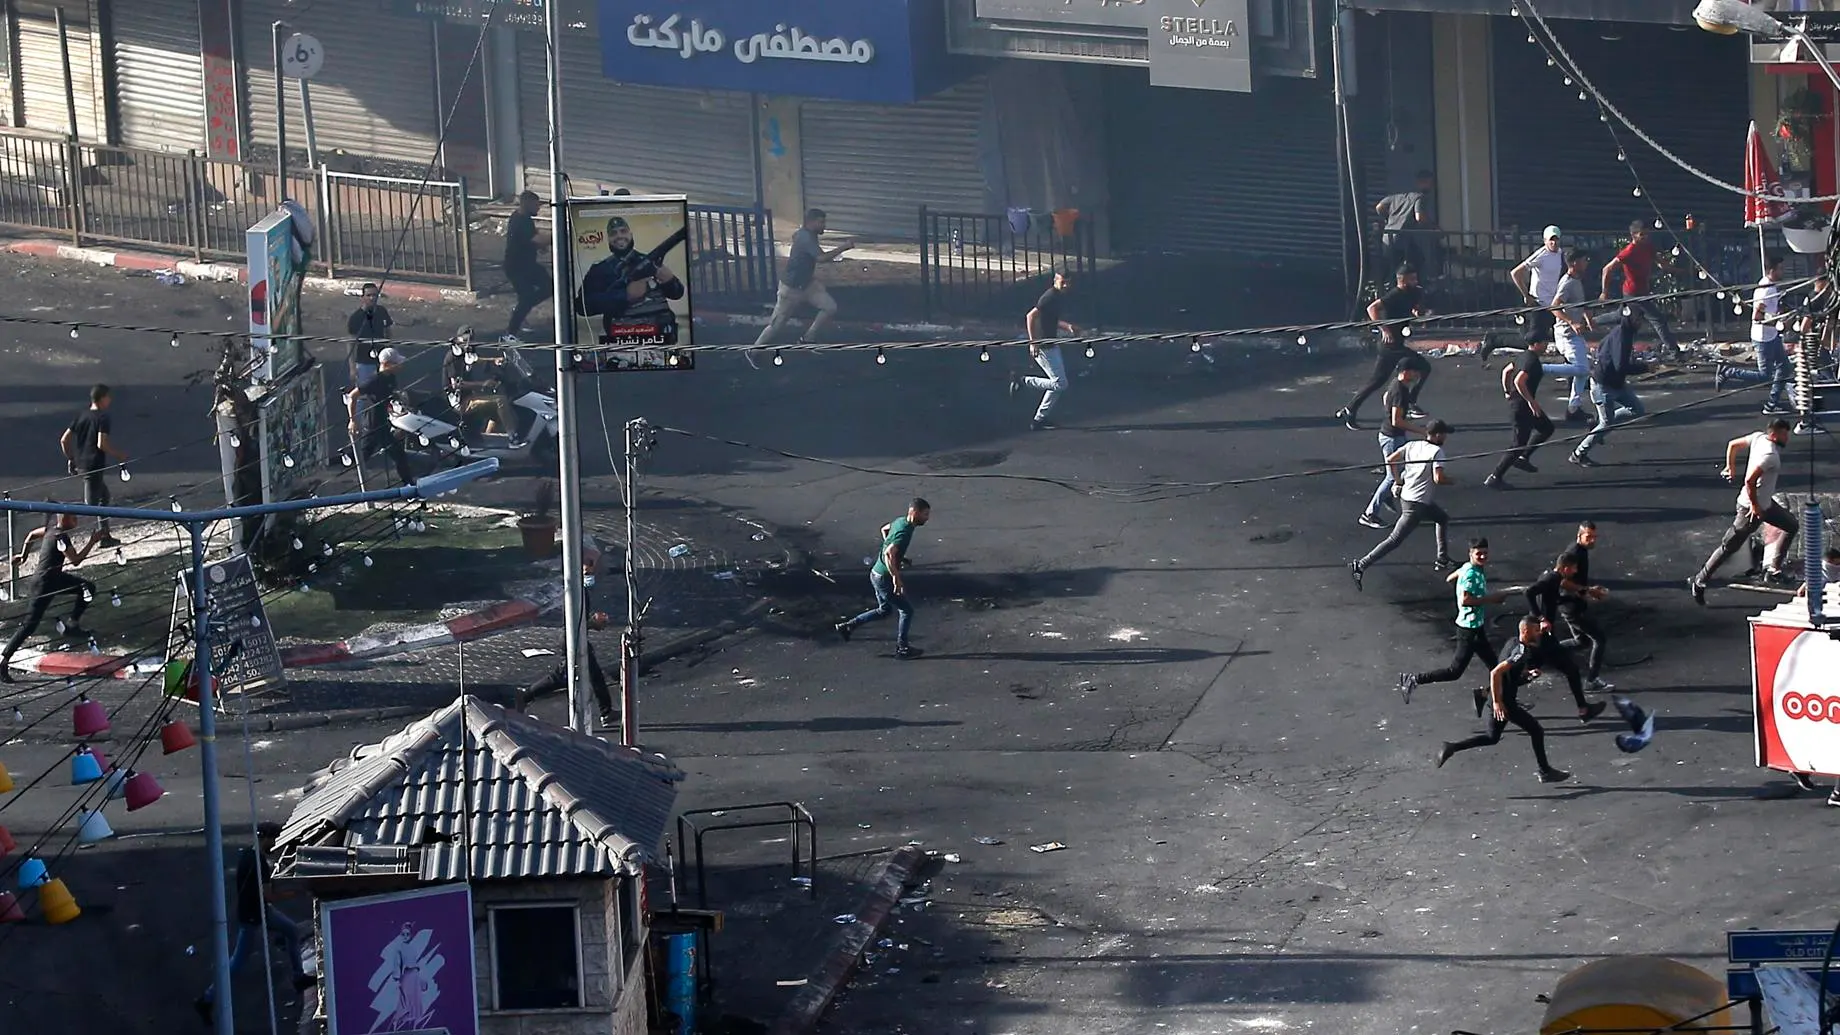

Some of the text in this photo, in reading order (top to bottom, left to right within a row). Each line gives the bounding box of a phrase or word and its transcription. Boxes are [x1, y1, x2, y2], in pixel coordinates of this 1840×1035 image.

[1160, 15, 1239, 36] STELLA
[626, 12, 875, 64] مصطفى ماركت
[1169, 34, 1231, 49] بصمة من الجمال
[642, 335, 665, 346] تامر
